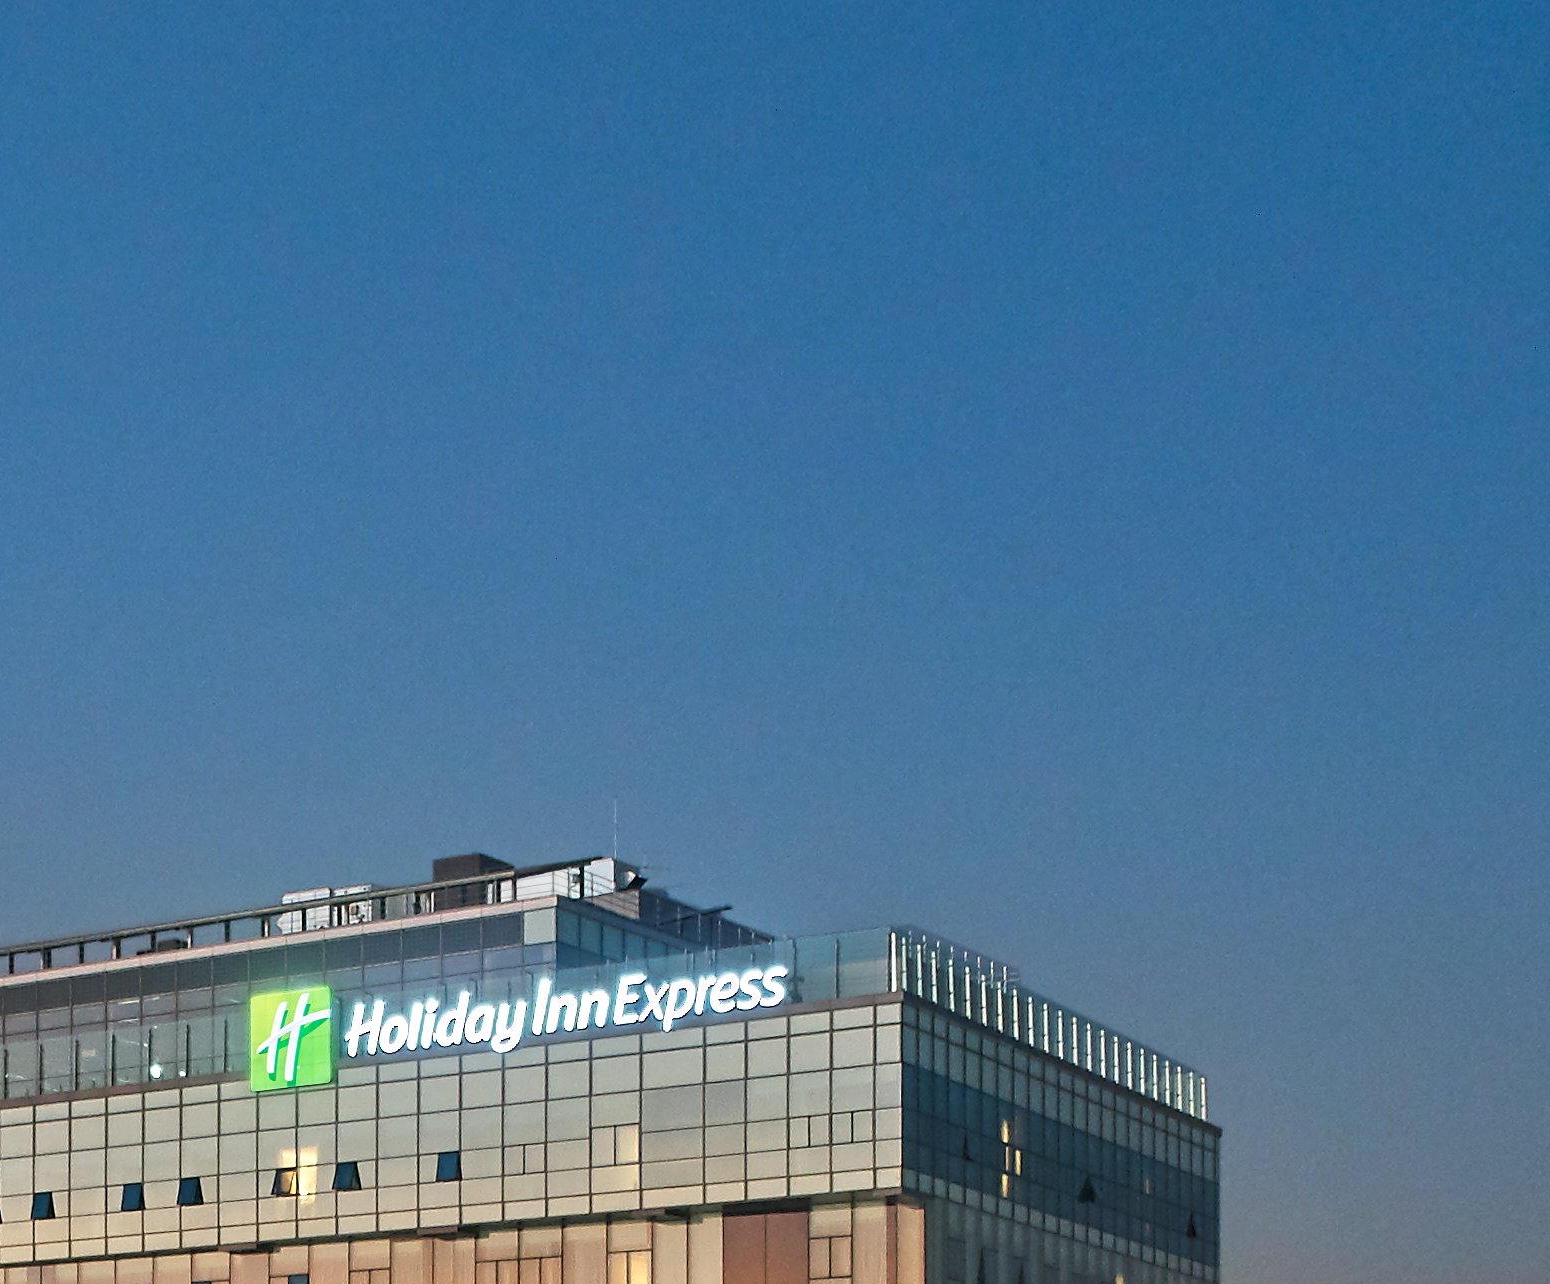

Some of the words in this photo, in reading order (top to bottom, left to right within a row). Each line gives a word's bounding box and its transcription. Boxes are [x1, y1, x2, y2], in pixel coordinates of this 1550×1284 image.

[345, 991, 527, 1056] Holiday
[531, 978, 610, 1036] Inn
[613, 967, 787, 1032] Express
